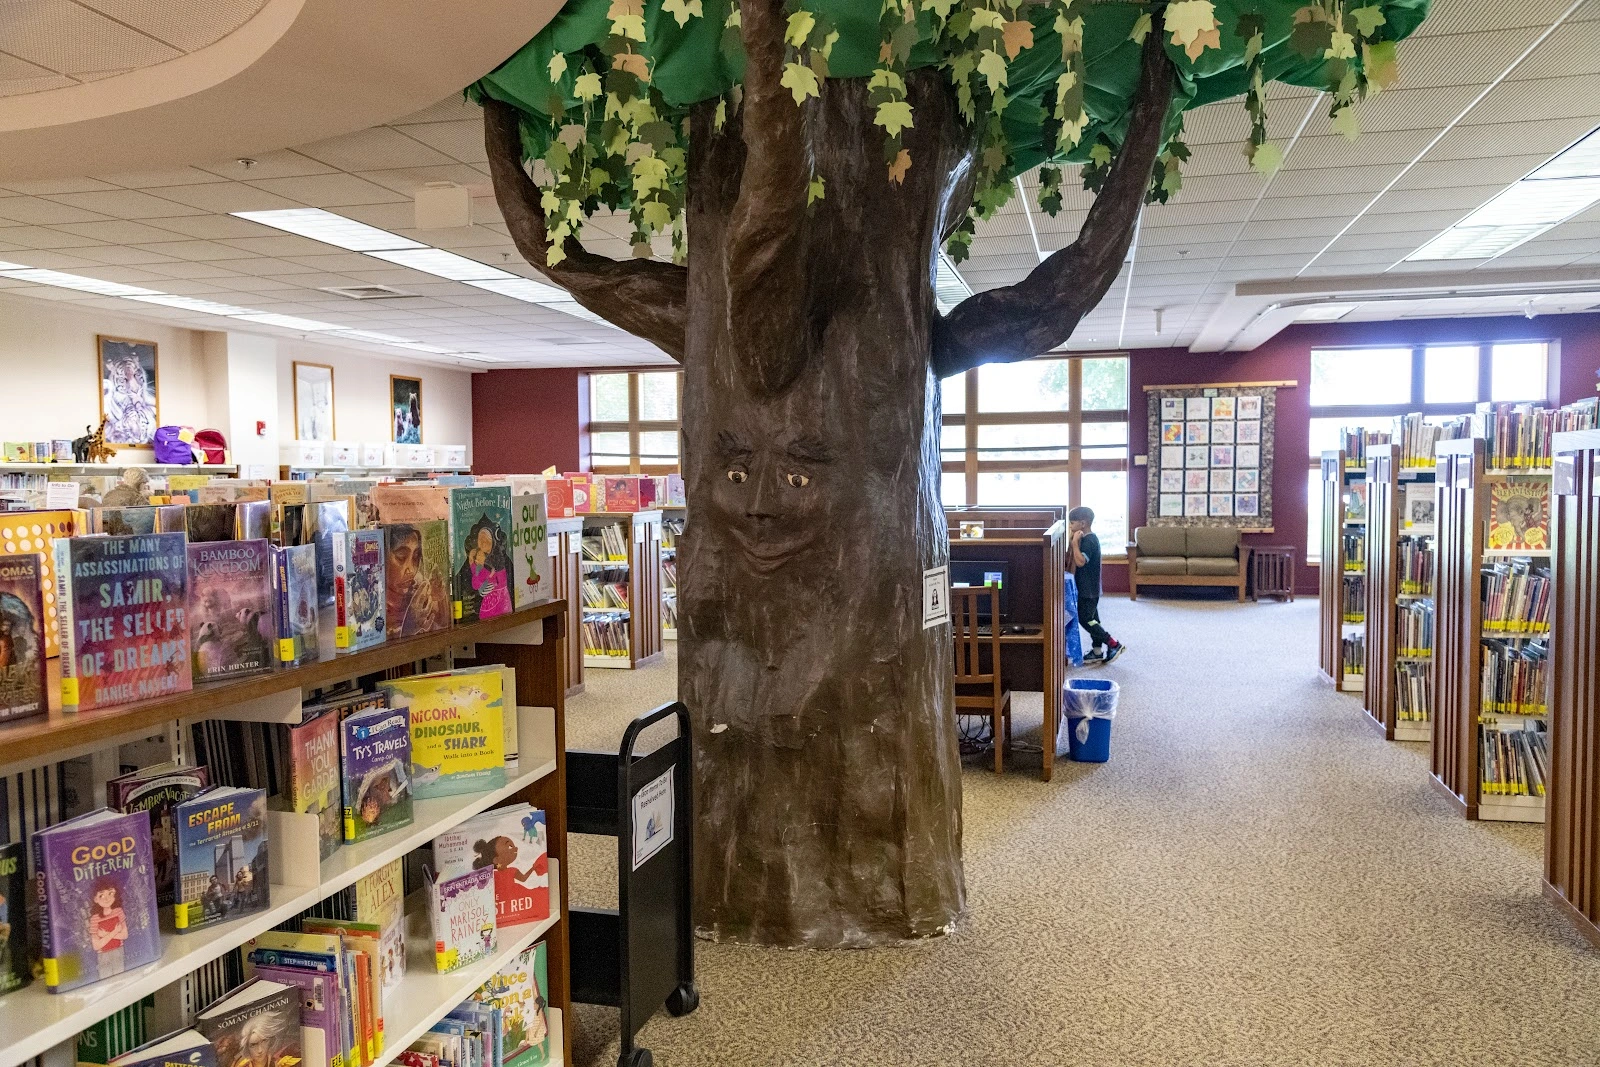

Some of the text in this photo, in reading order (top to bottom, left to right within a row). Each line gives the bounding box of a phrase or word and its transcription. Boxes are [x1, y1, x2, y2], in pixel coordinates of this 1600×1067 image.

[456, 498, 474, 511] Night
[475, 496, 496, 508] Before
[522, 503, 539, 523] our
[103, 537, 161, 556] THE MANY
[200, 548, 255, 562] BAMBOO
[75, 556, 170, 578] ASSASSINATIONS
[172, 554, 185, 569] OF
[193, 552, 261, 579] KINGDOM
[99, 577, 172, 609] SAMIR,
[59, 601, 67, 613] THE
[60, 615, 68, 639] SELLER
[80, 607, 186, 644] THE SELLER
[61, 641, 69, 650] OF
[61, 652, 71, 679] DREAMS
[81, 651, 105, 678] OF
[113, 639, 187, 673] DREAMS
[207, 665, 226, 674] ERIN
[228, 660, 260, 671] HUNTER
[95, 682, 134, 704] DANIEL
[411, 706, 461, 725] NiCORN,
[414, 721, 483, 739] DINOSAUR,
[304, 728, 336, 760] THANK
[352, 735, 408, 761] TY'S TRAVELS
[443, 735, 488, 751] SHARK
[310, 750, 330, 776] YOU
[443, 752, 459, 760] Walk
[188, 801, 235, 828] ESCAPE
[207, 813, 241, 835] FROM
[197, 833, 222, 846] Terrorist
[221, 826, 242, 837] Attacks
[246, 820, 259, 829] 9/11
[71, 836, 136, 865] GOOD
[36, 871, 47, 902] GOOD
[370, 878, 396, 914] ALEX
[458, 896, 480, 912] ONLY
[510, 896, 533, 913] RED
[450, 904, 489, 929] MARISOL
[451, 914, 489, 944] RAINEY
[269, 955, 276, 965] 2
[283, 957, 296, 965] STEP
[303, 959, 327, 968] READING
[521, 987, 532, 1000] a
[217, 1012, 248, 1031] SOMAN
[249, 997, 289, 1017] CHAINANI
